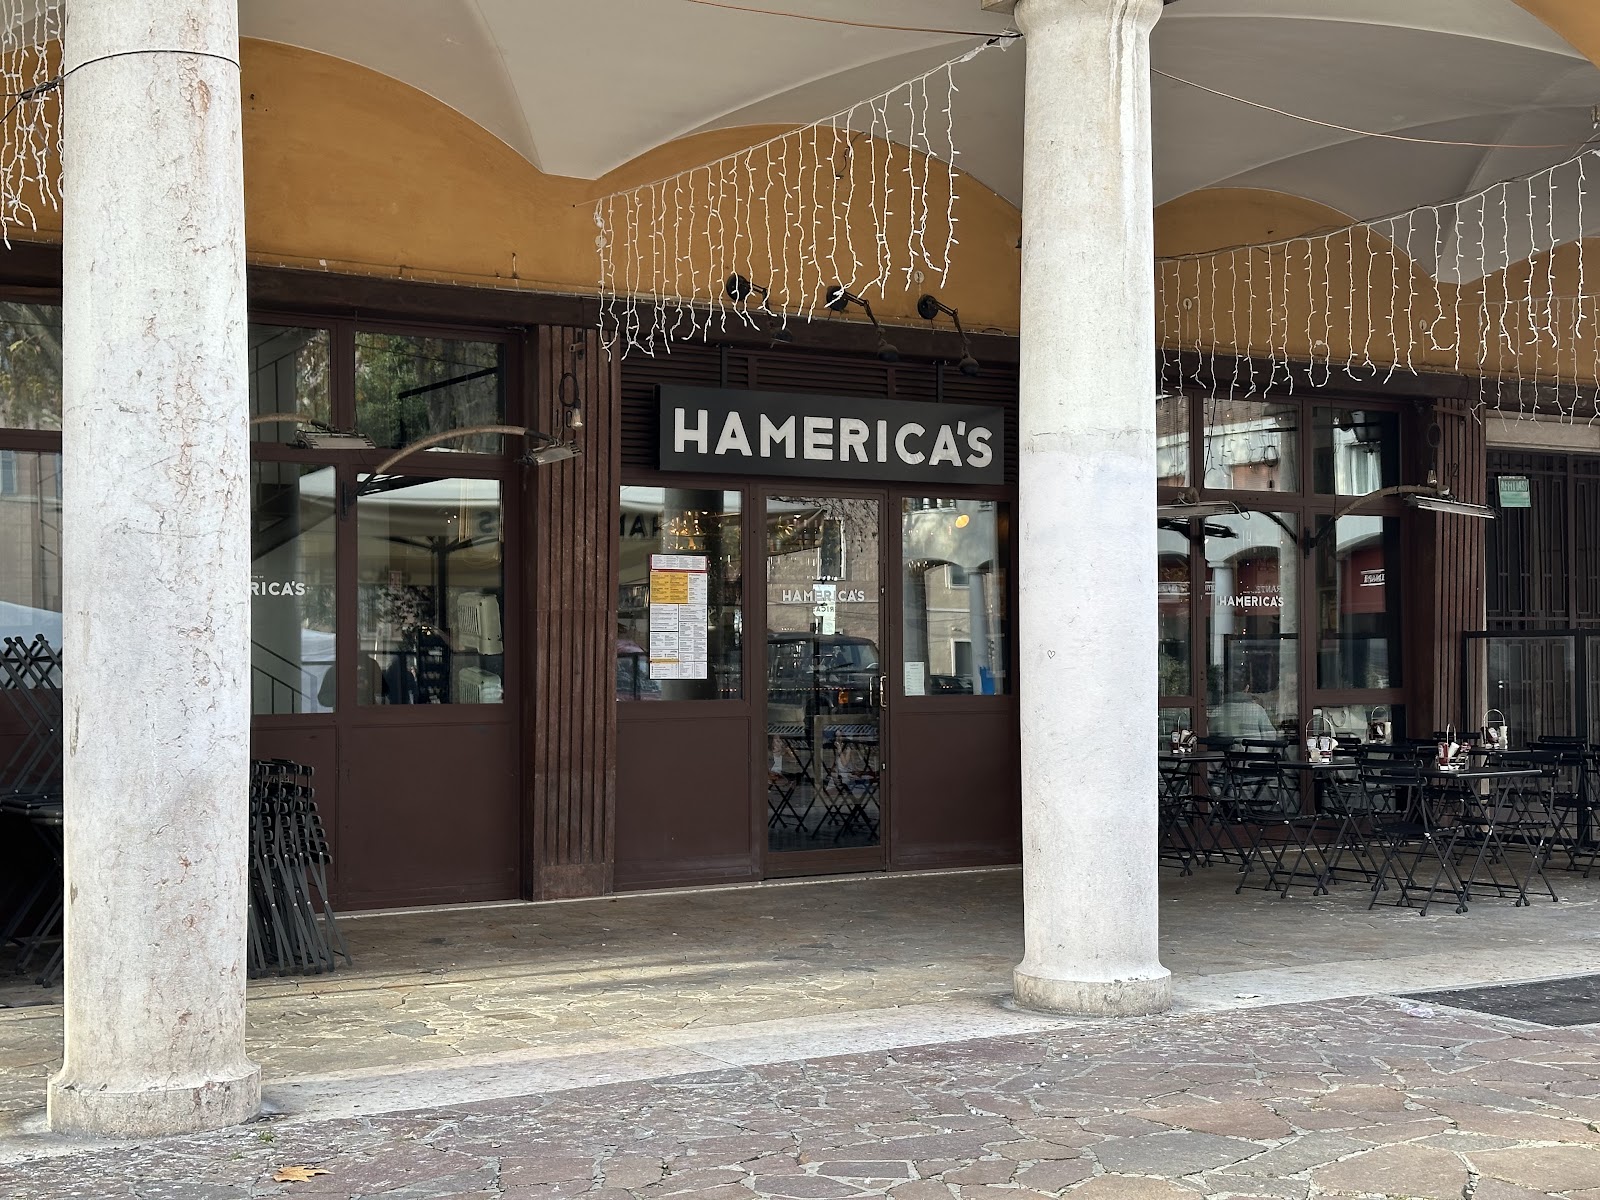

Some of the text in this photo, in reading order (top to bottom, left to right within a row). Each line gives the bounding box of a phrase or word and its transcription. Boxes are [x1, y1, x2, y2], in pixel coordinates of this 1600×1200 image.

[674, 407, 994, 468] HAMERICA'S
[782, 589, 865, 602] HAMERICA'S
[1219, 595, 1285, 607] HAMERICA'S
